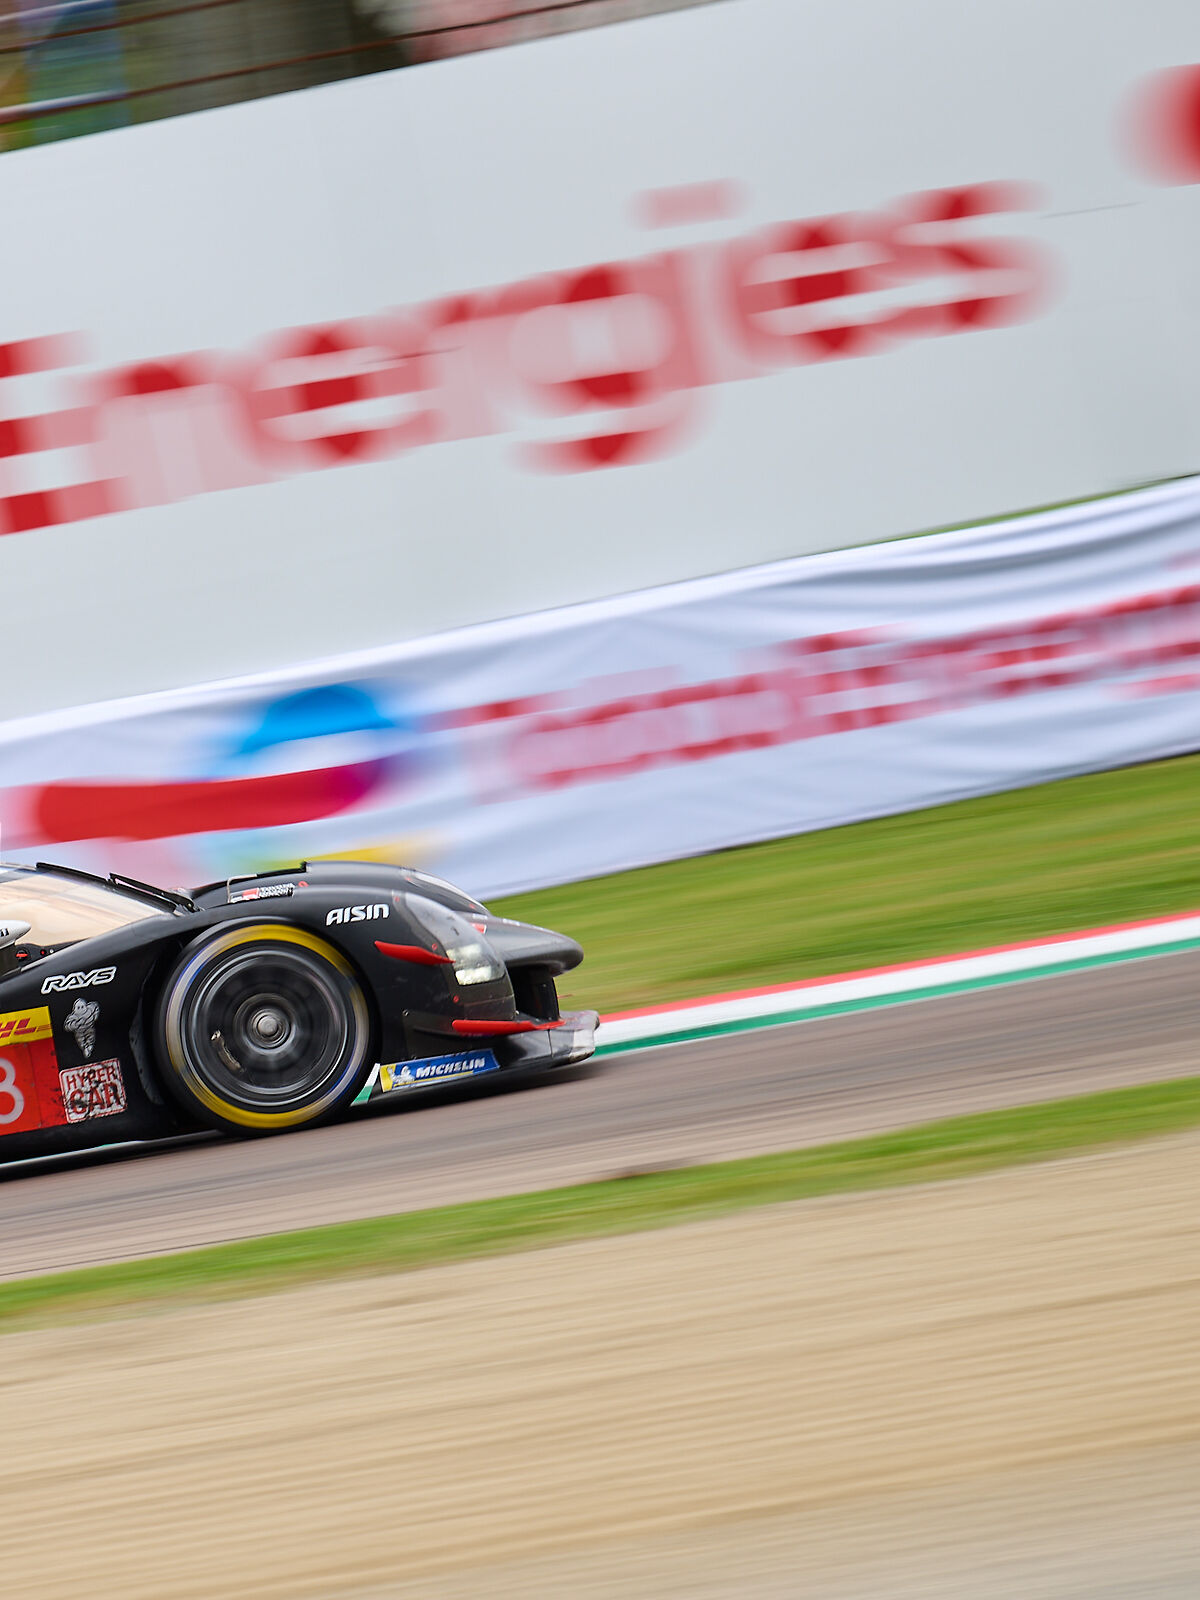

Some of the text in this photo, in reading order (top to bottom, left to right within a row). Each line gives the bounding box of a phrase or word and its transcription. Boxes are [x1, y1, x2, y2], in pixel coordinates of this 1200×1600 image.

[325, 903, 390, 926] AISIN
[41, 966, 117, 994] RAYS
[65, 1067, 116, 1091] HYPER
[415, 1057, 486, 1079] MICHELIN
[68, 1080, 121, 1116] CAR
